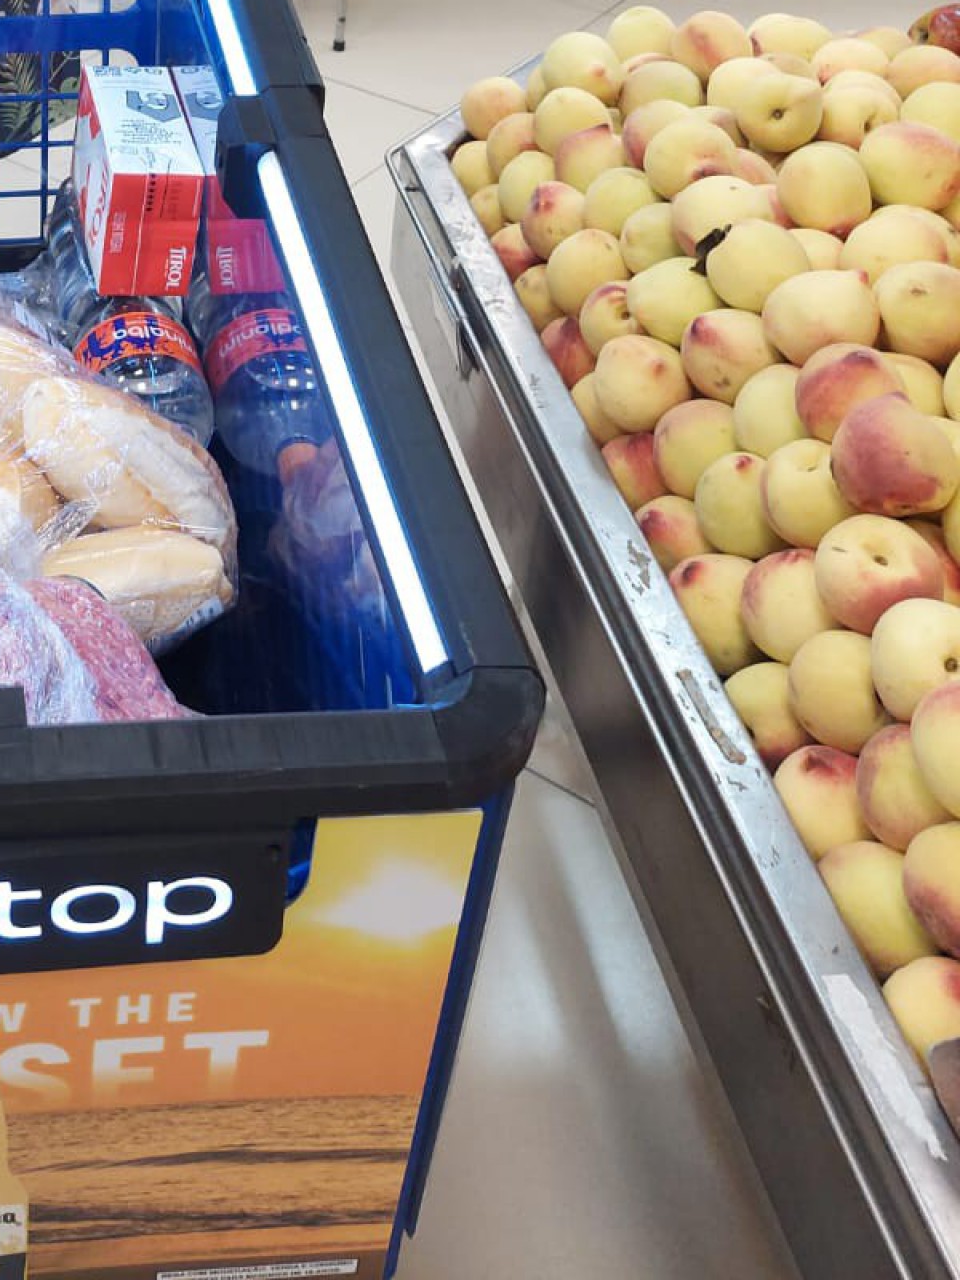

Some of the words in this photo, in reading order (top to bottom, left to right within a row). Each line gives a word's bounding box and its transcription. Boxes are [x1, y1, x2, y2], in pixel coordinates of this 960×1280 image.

[166, 246, 187, 291] TIROL
[112, 323, 192, 353] minalba
[69, 992, 198, 1029] THE
